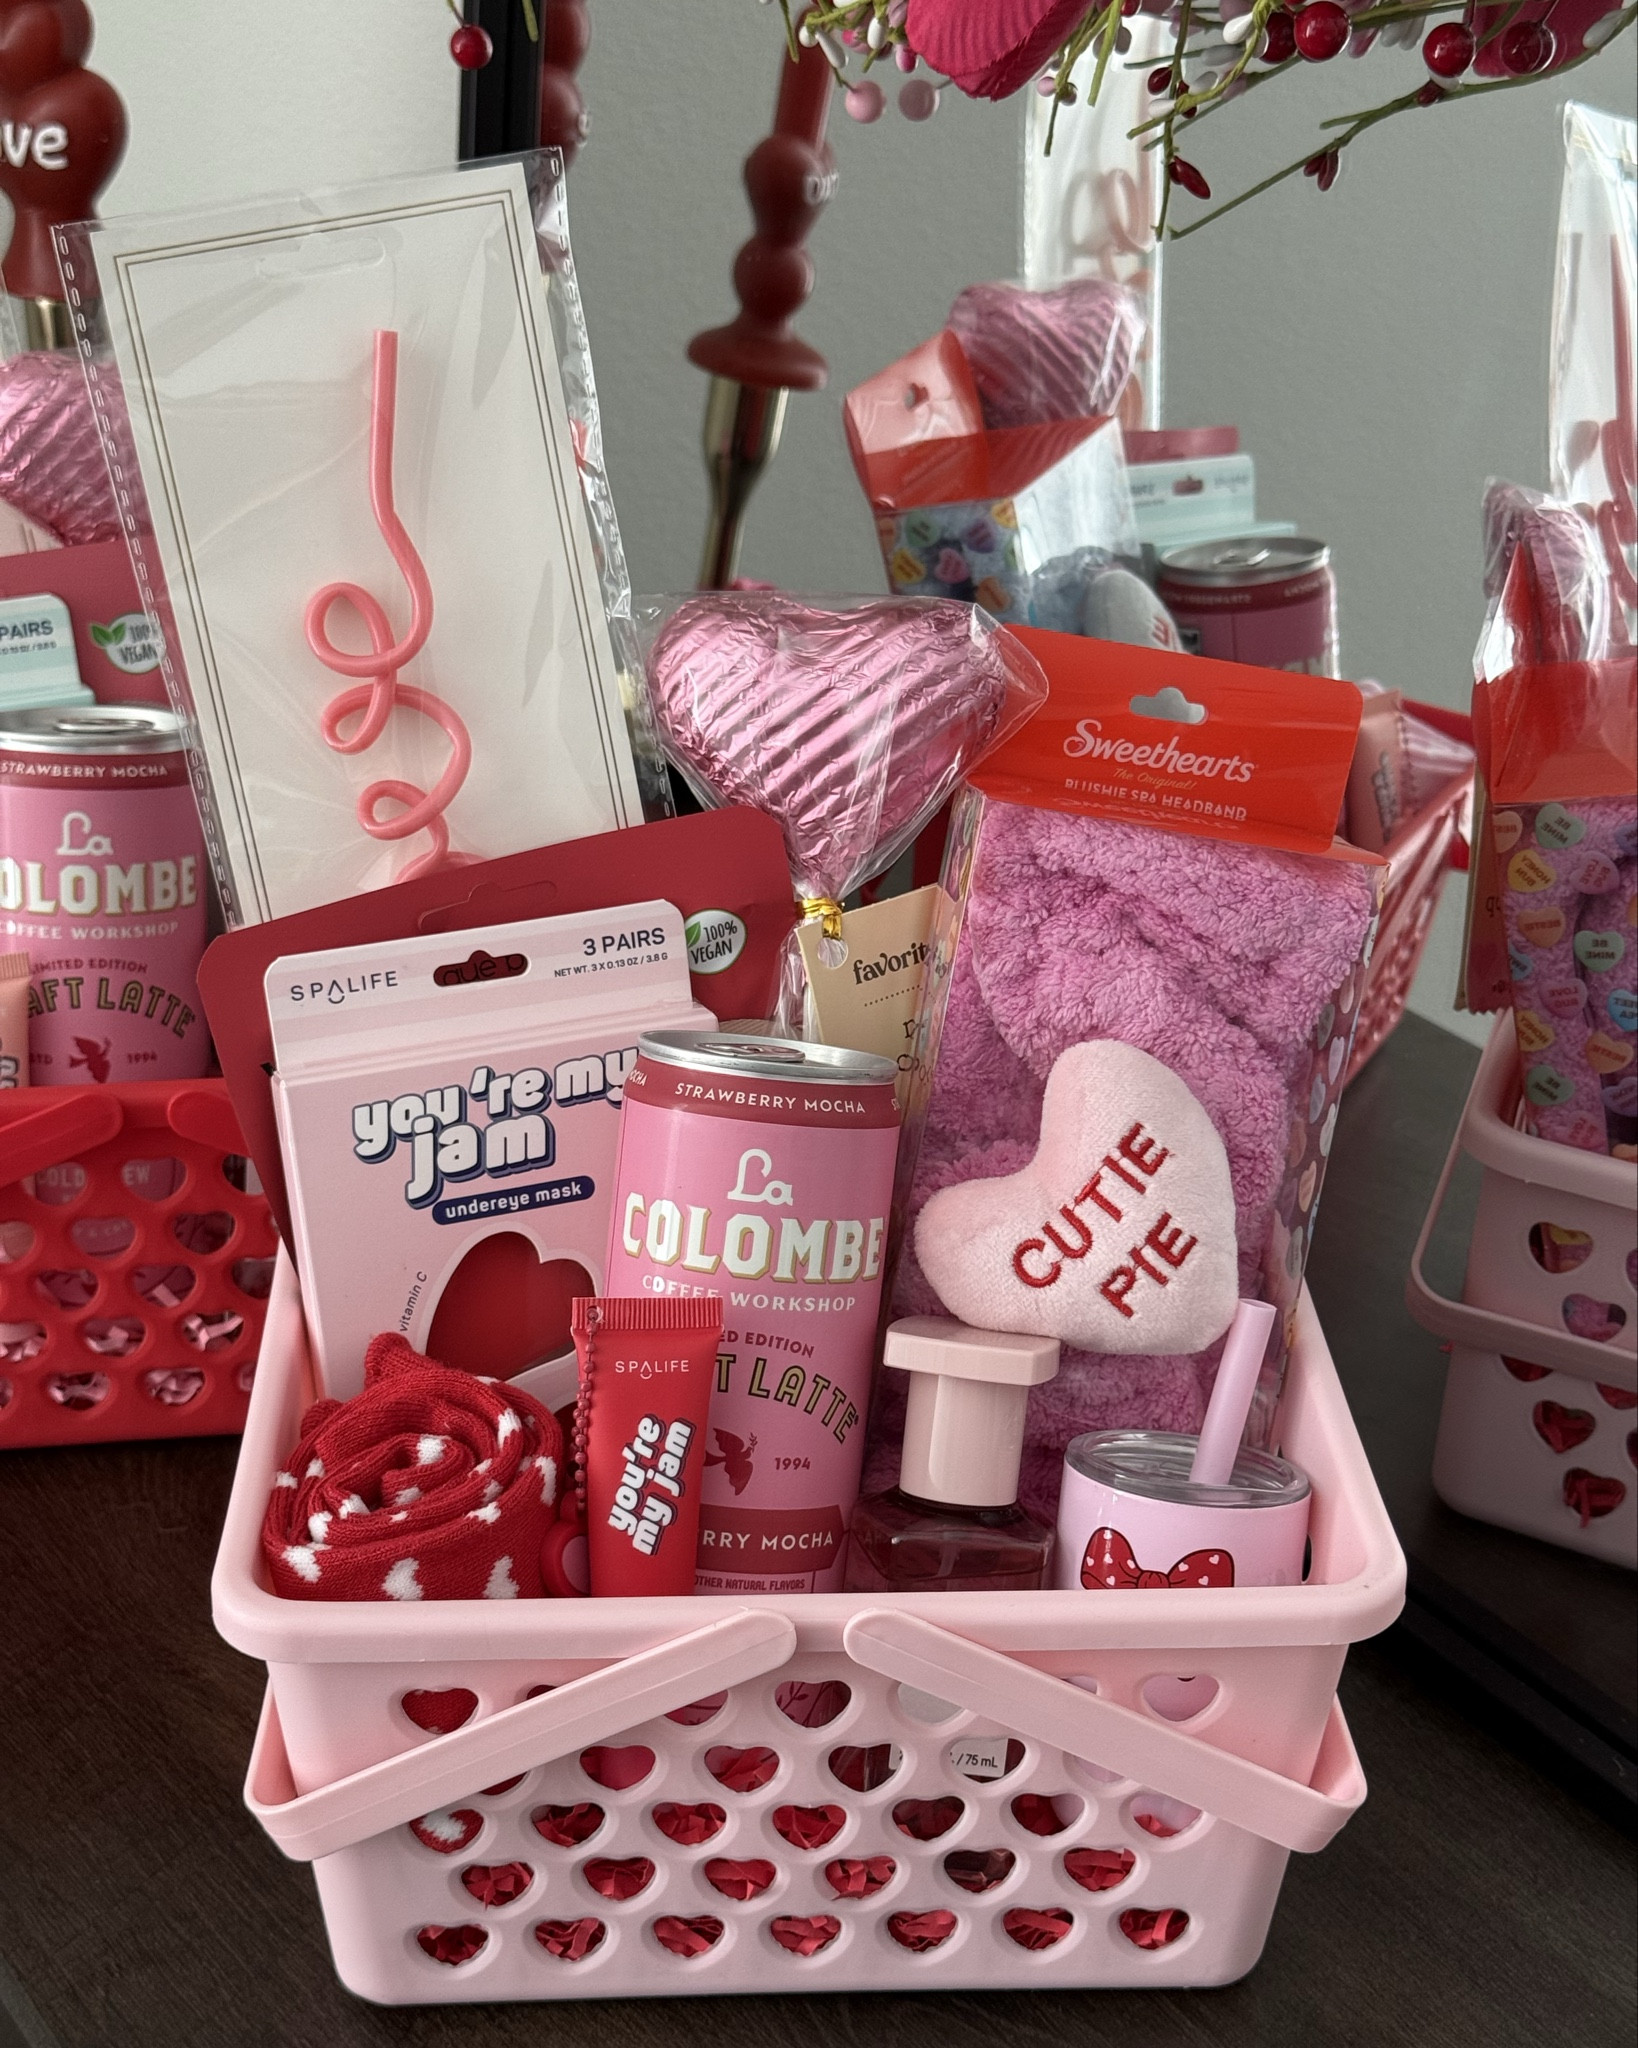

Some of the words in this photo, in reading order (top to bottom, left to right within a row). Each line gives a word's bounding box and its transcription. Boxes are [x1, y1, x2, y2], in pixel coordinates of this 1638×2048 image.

[0, 122, 69, 171] ve
[1063, 719, 1255, 783] Sweethearts
[0, 762, 106, 778] STRAWBERRY
[111, 766, 168, 778] MOCHA
[1113, 768, 1134, 780] The
[1131, 789, 1157, 804] SPA
[1162, 794, 1248, 821] HEADBAND
[57, 811, 114, 856] La
[71, 921, 179, 940] WORKSHOP
[583, 938, 597, 956] 3
[602, 928, 665, 953] PAIRS
[703, 920, 738, 943] 100%
[32, 957, 84, 975] IMITED
[88, 958, 149, 974] EDITION
[554, 967, 572, 978] NET
[573, 964, 590, 976] WT.
[592, 963, 598, 972] 3
[598, 962, 606, 971] X
[606, 959, 626, 969] 0.13
[627, 957, 639, 967] OZ
[646, 952, 660, 963] 3.8
[661, 952, 668, 961] G
[691, 938, 733, 965] VEGAN
[853, 941, 931, 985] favorit
[97, 976, 193, 1039] LATTE
[127, 1053, 159, 1065] 1994
[352, 1066, 552, 1164] you're
[554, 1046, 639, 1110] my
[675, 1082, 797, 1110] STRAWBERRY
[804, 1098, 866, 1114] MOCHA
[405, 1112, 555, 1210] jam
[727, 1148, 794, 1206] La
[445, 1193, 530, 1220] undereye
[535, 1181, 582, 1204] mask
[1012, 1122, 1169, 1288] CUTIE
[623, 1191, 885, 1284] COLOMBE
[1100, 1212, 1198, 1318] PIE
[399, 1284, 422, 1332] vitamin
[416, 1271, 428, 1282] C
[730, 1291, 856, 1313] WORKSHOP
[745, 1332, 815, 1359] EDITION
[748, 1357, 858, 1444] LATTE
[607, 1413, 664, 1536] you're
[646, 1417, 697, 1498] jam
[774, 1457, 811, 1470] 1994
[632, 1494, 679, 1556] my
[761, 1530, 833, 1550] MOCHA
[725, 1578, 767, 1591] NATURAL
[769, 1578, 805, 1591] FLAVORS
[966, 1754, 979, 1766] 75
[980, 1756, 998, 1768] mL
